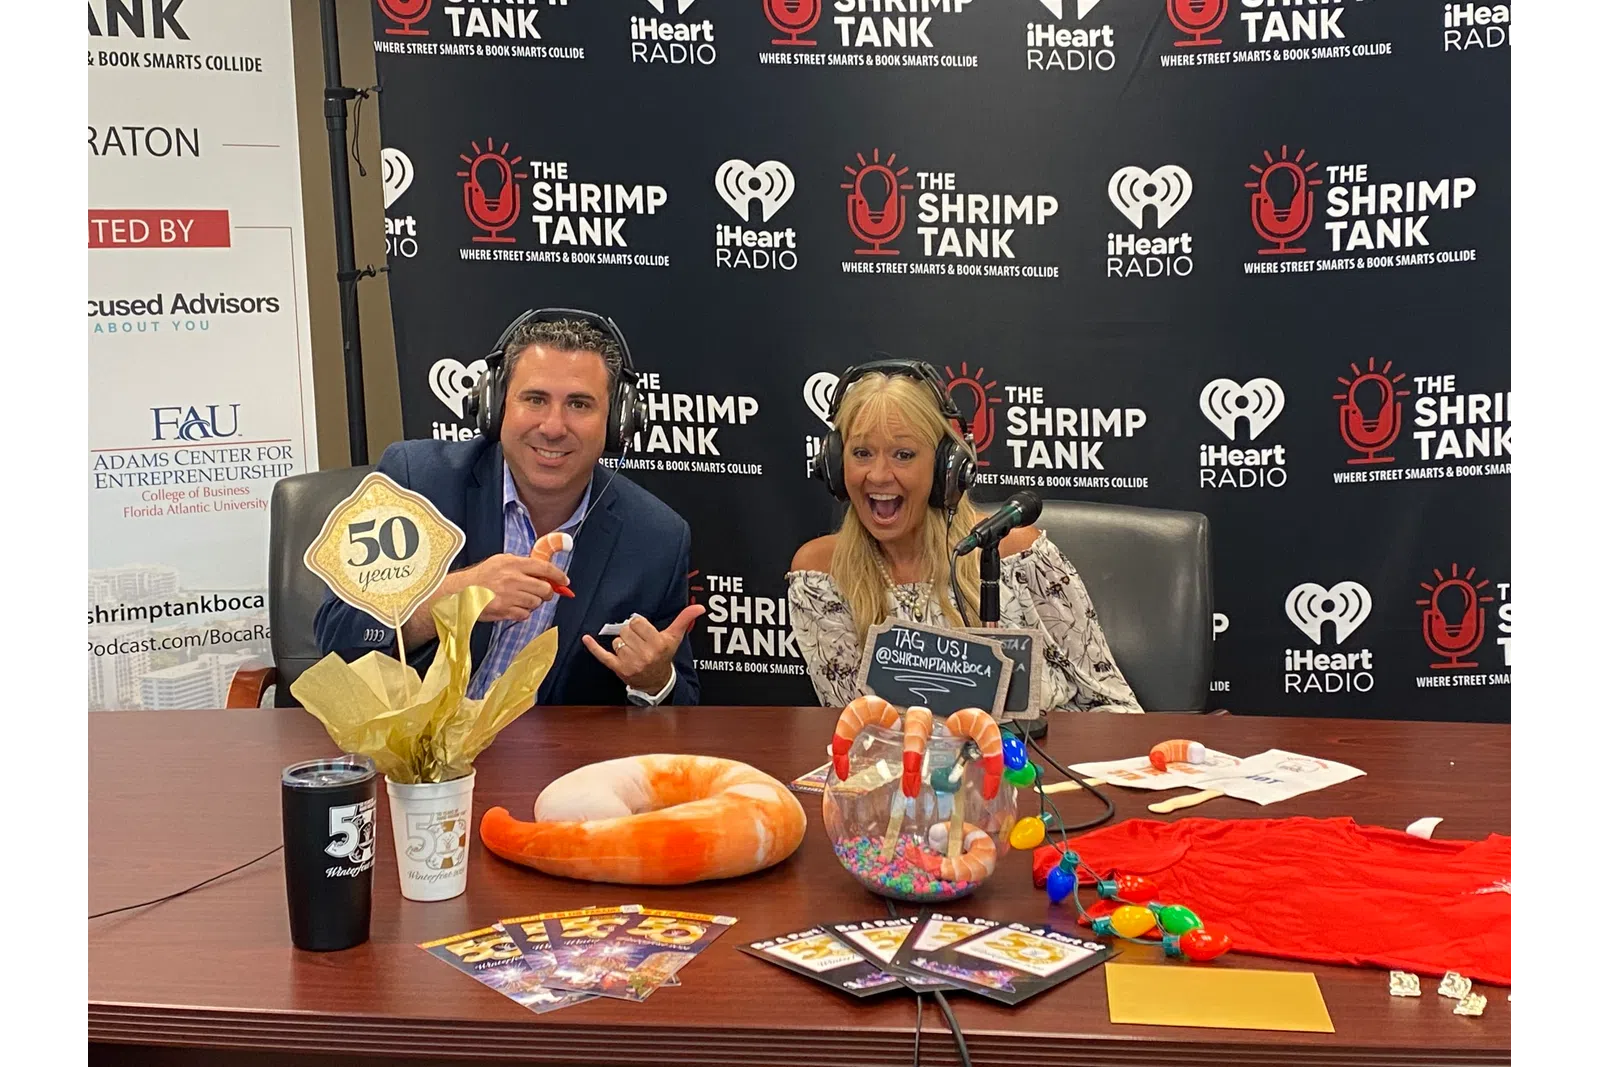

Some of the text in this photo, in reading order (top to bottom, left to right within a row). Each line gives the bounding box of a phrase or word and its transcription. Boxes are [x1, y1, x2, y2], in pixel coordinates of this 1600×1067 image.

[444, 7, 542, 39] TANK
[1240, 7, 1345, 43] TANK
[1444, 3, 1512, 28] iHea
[630, 16, 714, 41] iHeart
[834, 16, 934, 47] TANK
[1026, 23, 1114, 47] iHeart
[374, 41, 585, 59] WHERE STREET SMARTS & BOOK SMARTS COLLIDE
[631, 42, 716, 64] RADIO
[759, 53, 978, 67] WHERE STREET SMARTS & BOOK SMARTS COLLIDE
[1027, 49, 1116, 71] RADIO
[1161, 43, 1392, 67] WHERE STREET SMARTS & BOOK SMARTS COLLIDE
[98, 51, 263, 73] BOOK SMARTS COLLIDE
[530, 161, 568, 179] THE
[917, 172, 955, 190] THE
[1326, 164, 1368, 184] THE
[532, 181, 668, 214] SHRIMP
[917, 193, 1059, 225] SHRIMP
[1326, 177, 1477, 218] SHRIMP
[88, 219, 195, 243] TED BY
[532, 214, 627, 247] TANK
[716, 223, 796, 248] iHeart
[1325, 215, 1429, 252] TANK
[917, 227, 1015, 258] TANK
[1107, 232, 1192, 255] iHeart
[460, 249, 670, 266] WHERE STREET SMARTS & BOOK SMARTS COLLIDE
[716, 248, 797, 270] RADIO
[1107, 256, 1193, 277] RADIO
[1244, 249, 1476, 274] WHERE STREET SMARTS & BOOK SMARTS COLLIDE
[842, 262, 1059, 278] WHERE STREET SMARTS & BOOK SMARTS COLLIDE
[170, 293, 280, 315] Advisors
[94, 320, 209, 333] ABOUT YOU
[636, 372, 661, 390] HE
[1413, 375, 1455, 394] THE
[1005, 386, 1043, 404] THE
[639, 392, 759, 424] HRIMP
[1414, 391, 1512, 427] SHRI
[150, 403, 241, 441] FAU
[432, 421, 481, 442] iHe
[1006, 406, 1147, 437] SHRIMP
[1006, 439, 1104, 470] TANK
[1413, 426, 1512, 460] TANK
[93, 445, 293, 471] ADAMS CENTER FOR
[621, 458, 762, 474] SMARTS & BOOK SMARTS COLLIDE
[1200, 444, 1286, 467] iHeart
[95, 463, 293, 489] ENTREPRENEURSHIP
[1000, 475, 1036, 486] SMARTS
[1037, 476, 1045, 487] &
[1047, 476, 1072, 487] BOOK
[1073, 477, 1110, 488] SMARTS
[1111, 477, 1148, 488] COLLIDE
[1200, 467, 1287, 488] RADIO
[1333, 471, 1367, 484] WHERE
[1369, 469, 1403, 482] STREET
[1405, 467, 1444, 479] SMARTS
[1446, 466, 1454, 478] &
[1456, 464, 1483, 477] BOOK
[141, 485, 250, 502] College of Business
[123, 499, 269, 518] Florida Atlantic University
[347, 516, 420, 567] 50
[359, 564, 416, 593] years
[706, 575, 743, 593] THE
[707, 626, 800, 658] TANK
[891, 627, 968, 660] TAG US!
[700, 661, 734, 672] SMARTS
[736, 662, 743, 672] &
[745, 662, 768, 673] BOOK
[770, 663, 804, 675] SMARTS
[875, 647, 991, 678] @SHRIMPTANKBOCA
[1285, 649, 1373, 671] iHeart
[1285, 672, 1374, 693] RADIO
[1416, 674, 1512, 688] WHERE STREET SMA
